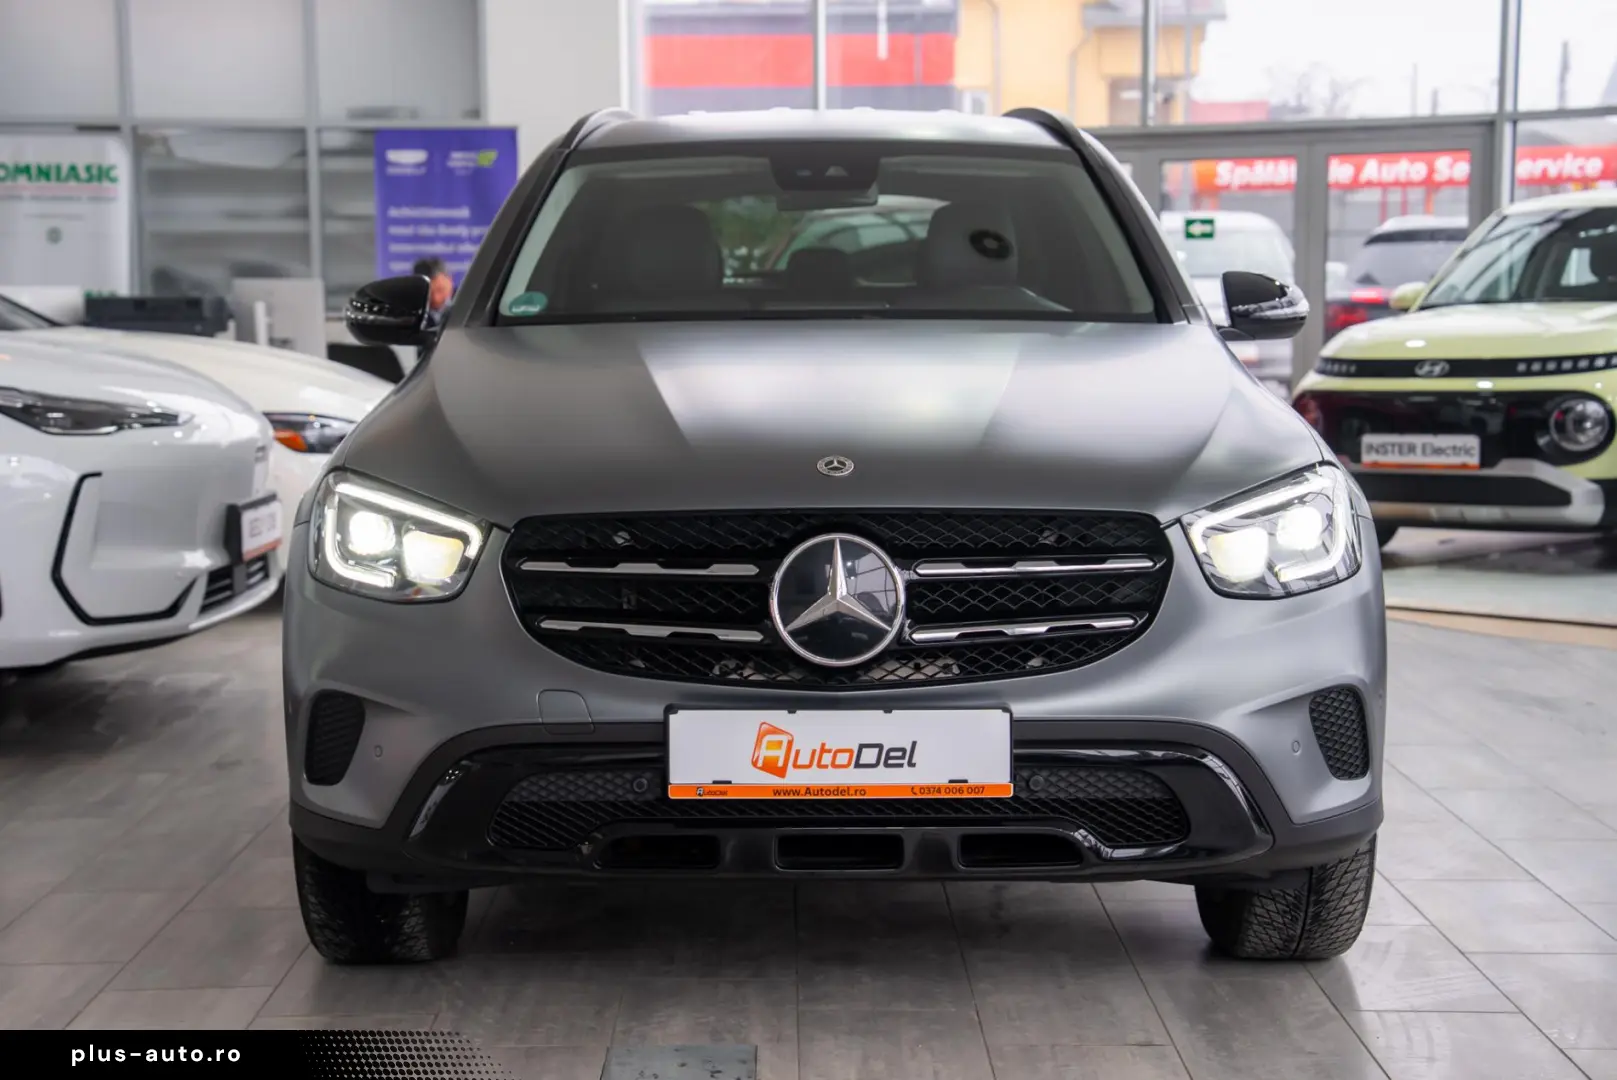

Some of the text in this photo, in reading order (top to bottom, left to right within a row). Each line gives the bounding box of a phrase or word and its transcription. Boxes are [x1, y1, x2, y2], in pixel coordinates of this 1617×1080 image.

[1358, 157, 1428, 184] Auto
[1515, 152, 1604, 179] ervice
[1364, 441, 1477, 458] INSTER Electric
[753, 731, 918, 771] AutoDel
[772, 786, 867, 798] www.Autodel.ro
[919, 785, 942, 796] 0374
[944, 785, 964, 795] 006
[966, 785, 985, 795] 007
